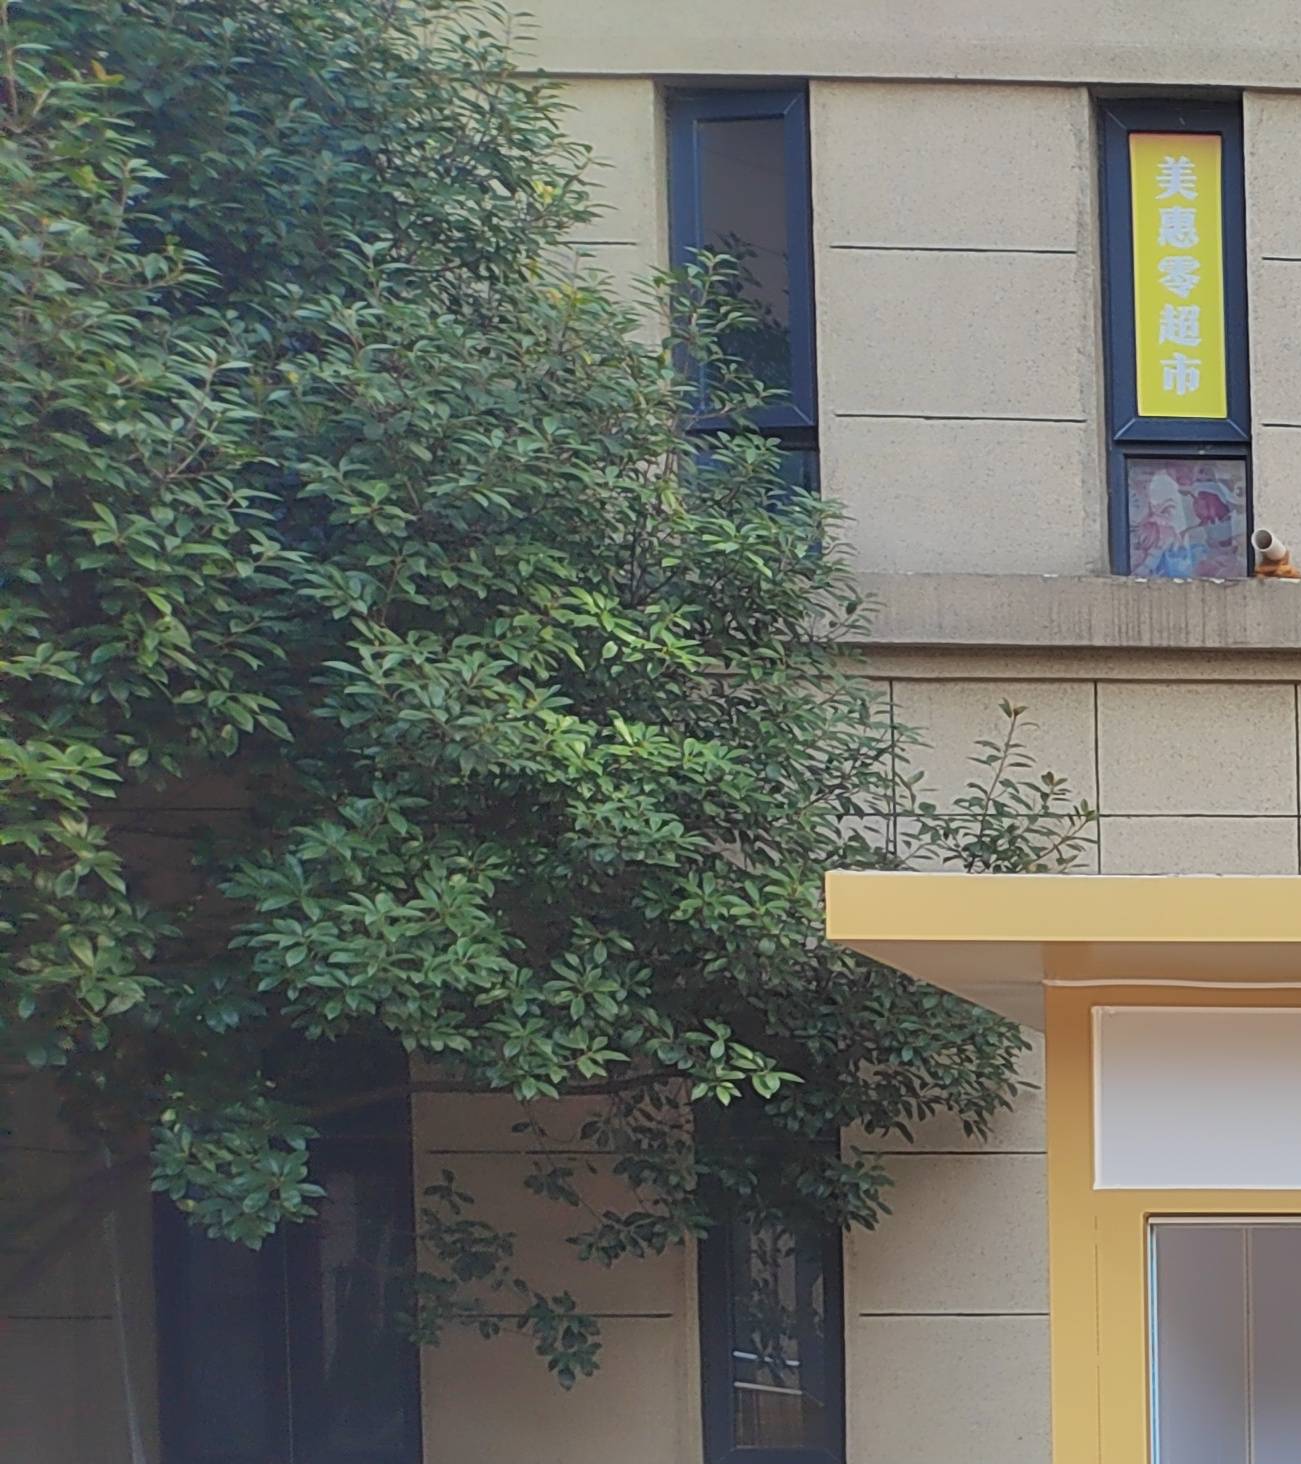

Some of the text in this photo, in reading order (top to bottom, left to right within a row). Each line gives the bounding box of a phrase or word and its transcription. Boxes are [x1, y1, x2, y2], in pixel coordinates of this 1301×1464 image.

[1155, 155, 1202, 396] 美惠零超市
